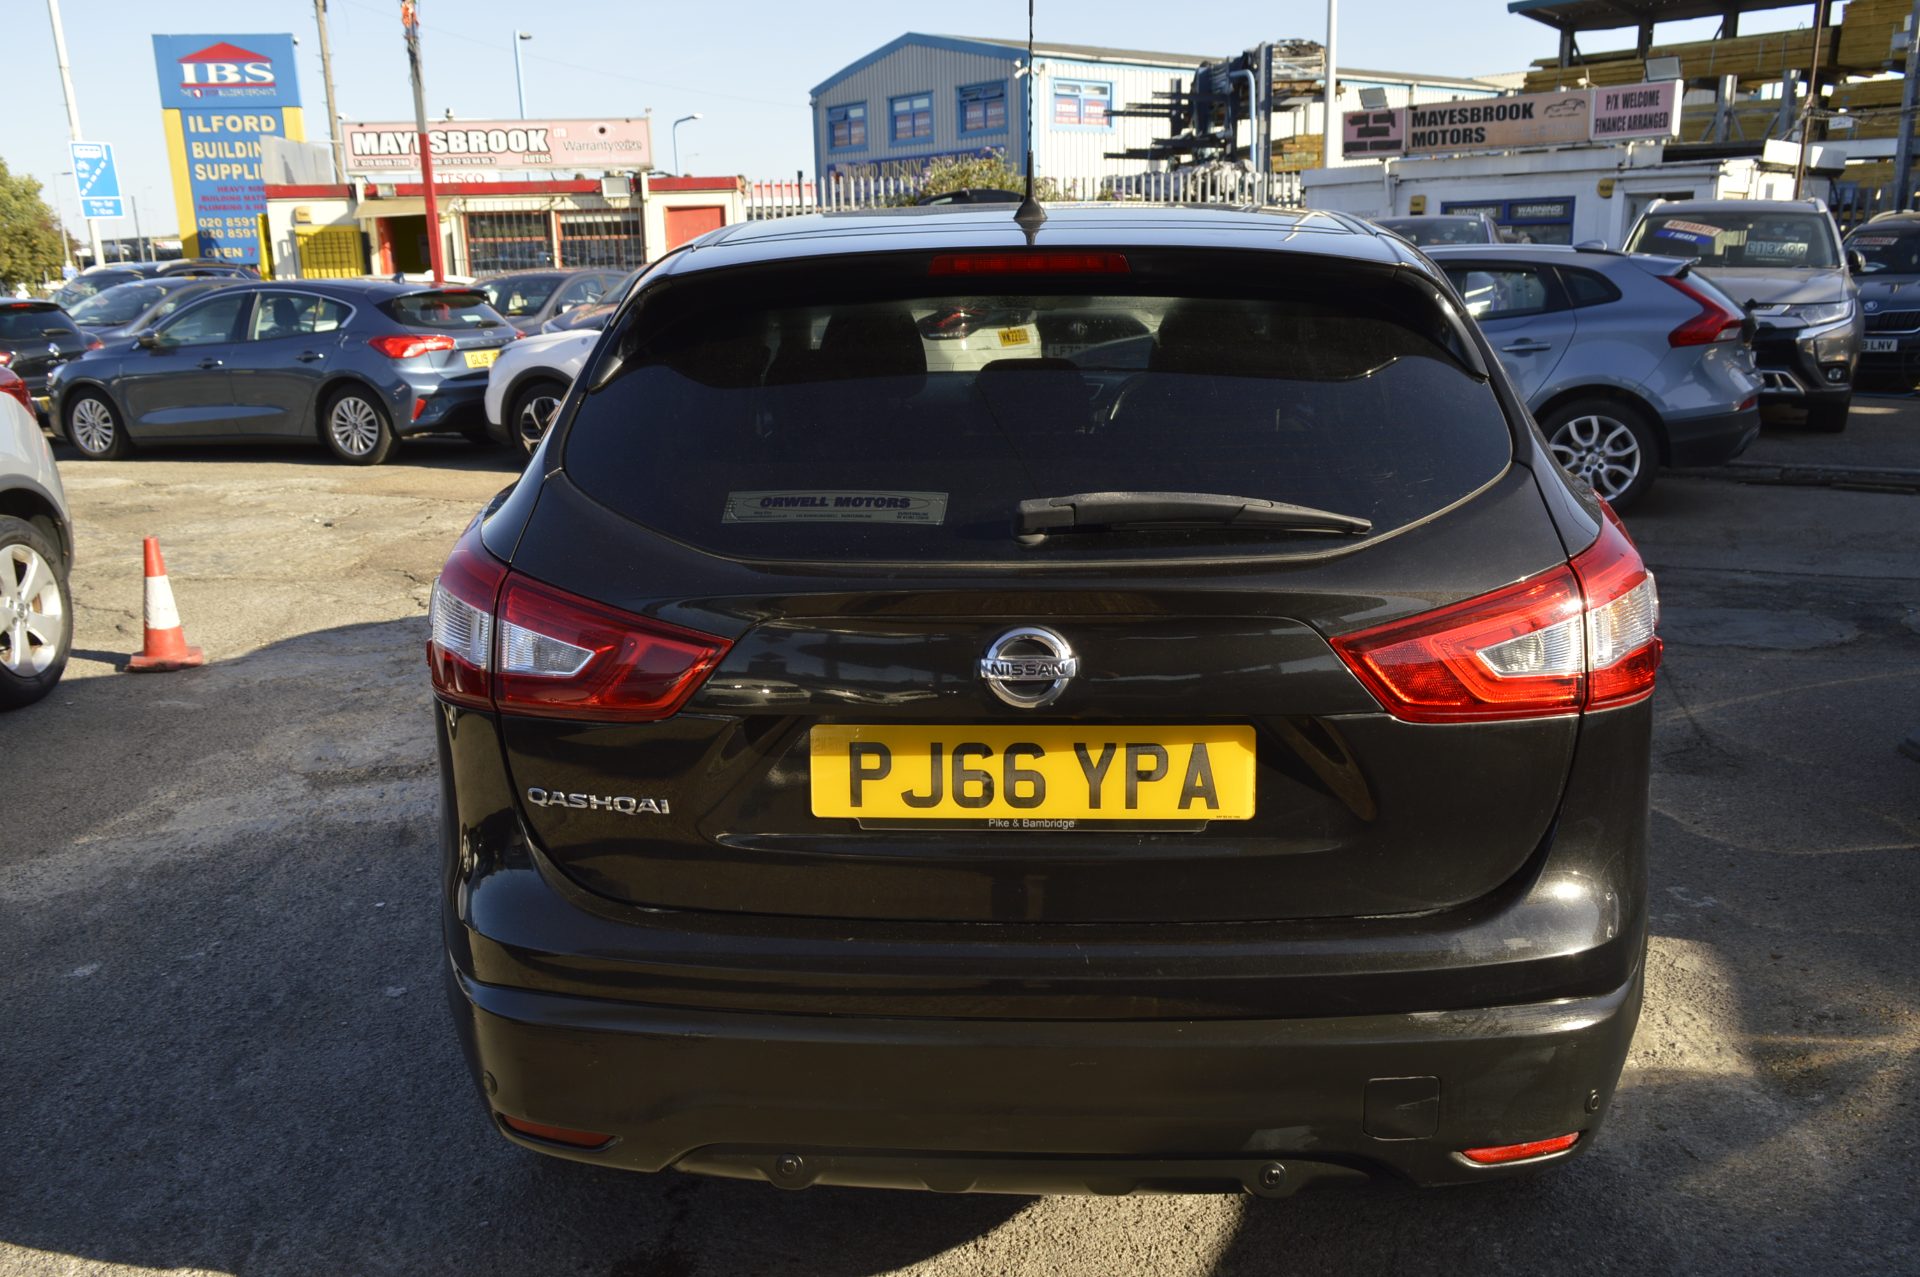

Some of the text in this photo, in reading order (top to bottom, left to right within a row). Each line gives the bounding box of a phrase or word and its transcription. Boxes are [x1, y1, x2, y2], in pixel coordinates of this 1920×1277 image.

[182, 62, 275, 84] IBS
[1622, 90, 1660, 108] WELCOME
[1411, 102, 1534, 128] MAYESBROOK
[1595, 116, 1626, 134] FINANCE
[1628, 112, 1669, 131] ARRANGED
[188, 115, 276, 133] ILFORD
[1411, 127, 1486, 149] MOTORS
[192, 141, 262, 158] BUILDIN
[195, 164, 261, 180] SUPPLI
[438, 173, 485, 183] TESCO
[1518, 205, 1564, 213] WARNING!
[199, 217, 222, 227] 020
[205, 248, 243, 258] OPEN
[1870, 340, 1893, 350] LNV
[760, 496, 911, 508] ORWELL MOTORS
[991, 663, 1066, 676] NISSAN
[849, 742, 1220, 810] PJ66 YPA
[527, 787, 670, 815] QASHQAI
[988, 818, 1075, 830] Pike & Bambridge
